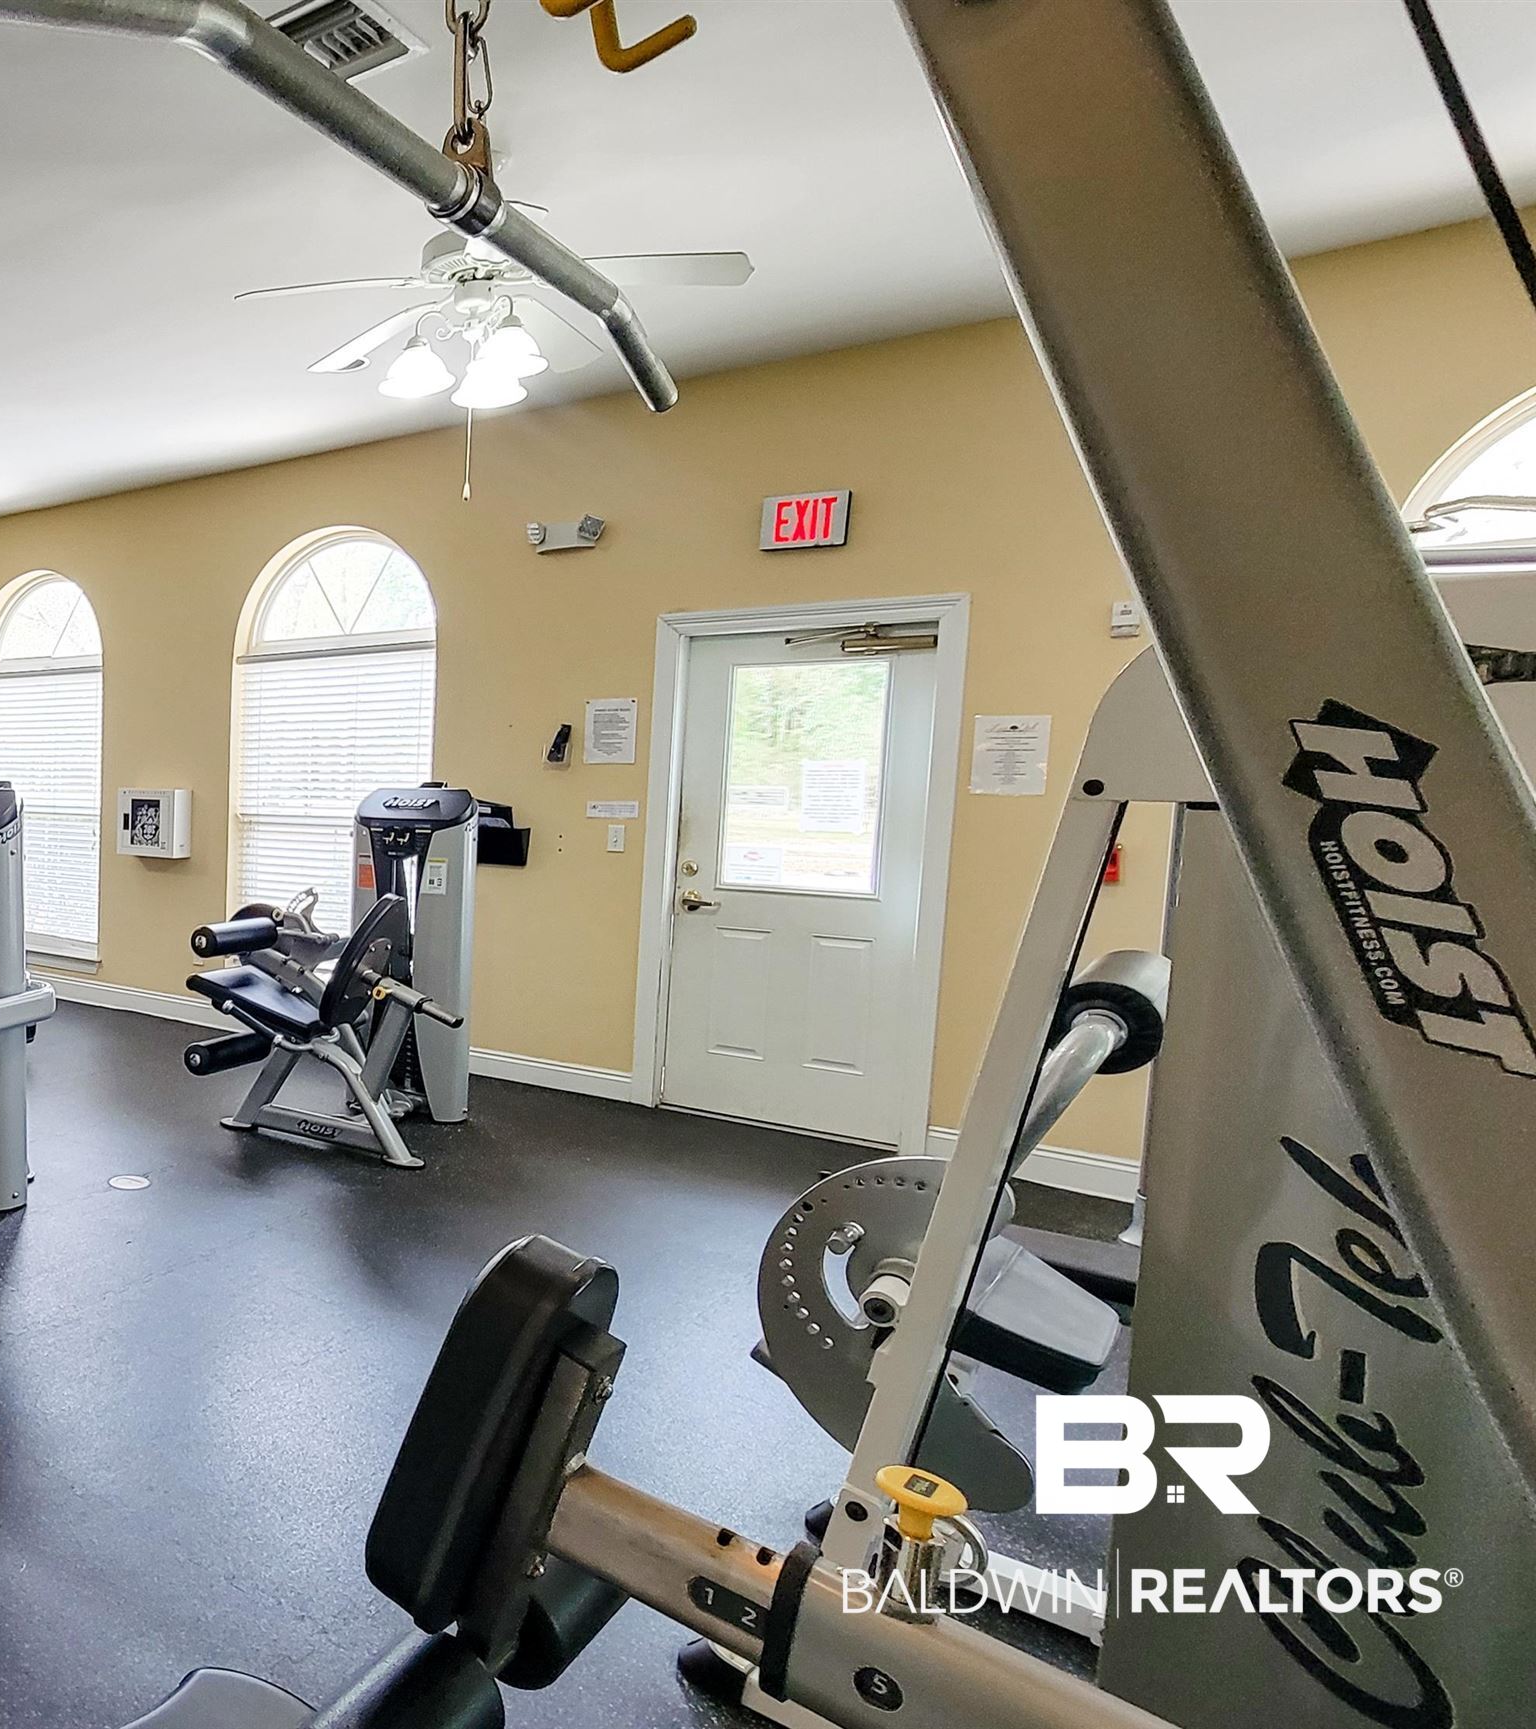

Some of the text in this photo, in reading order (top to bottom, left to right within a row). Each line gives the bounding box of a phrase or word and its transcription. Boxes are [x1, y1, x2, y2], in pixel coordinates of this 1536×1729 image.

[774, 496, 838, 543] EXIT
[383, 797, 441, 811] HOIST
[1282, 698, 1536, 1081] HOIST
[1320, 839, 1406, 1007] HOISTFITNESS.COM
[296, 1119, 343, 1139] HOIST
[704, 1587, 714, 1605] 1
[740, 1606, 758, 1628] 2
[871, 1674, 888, 1695] 5
